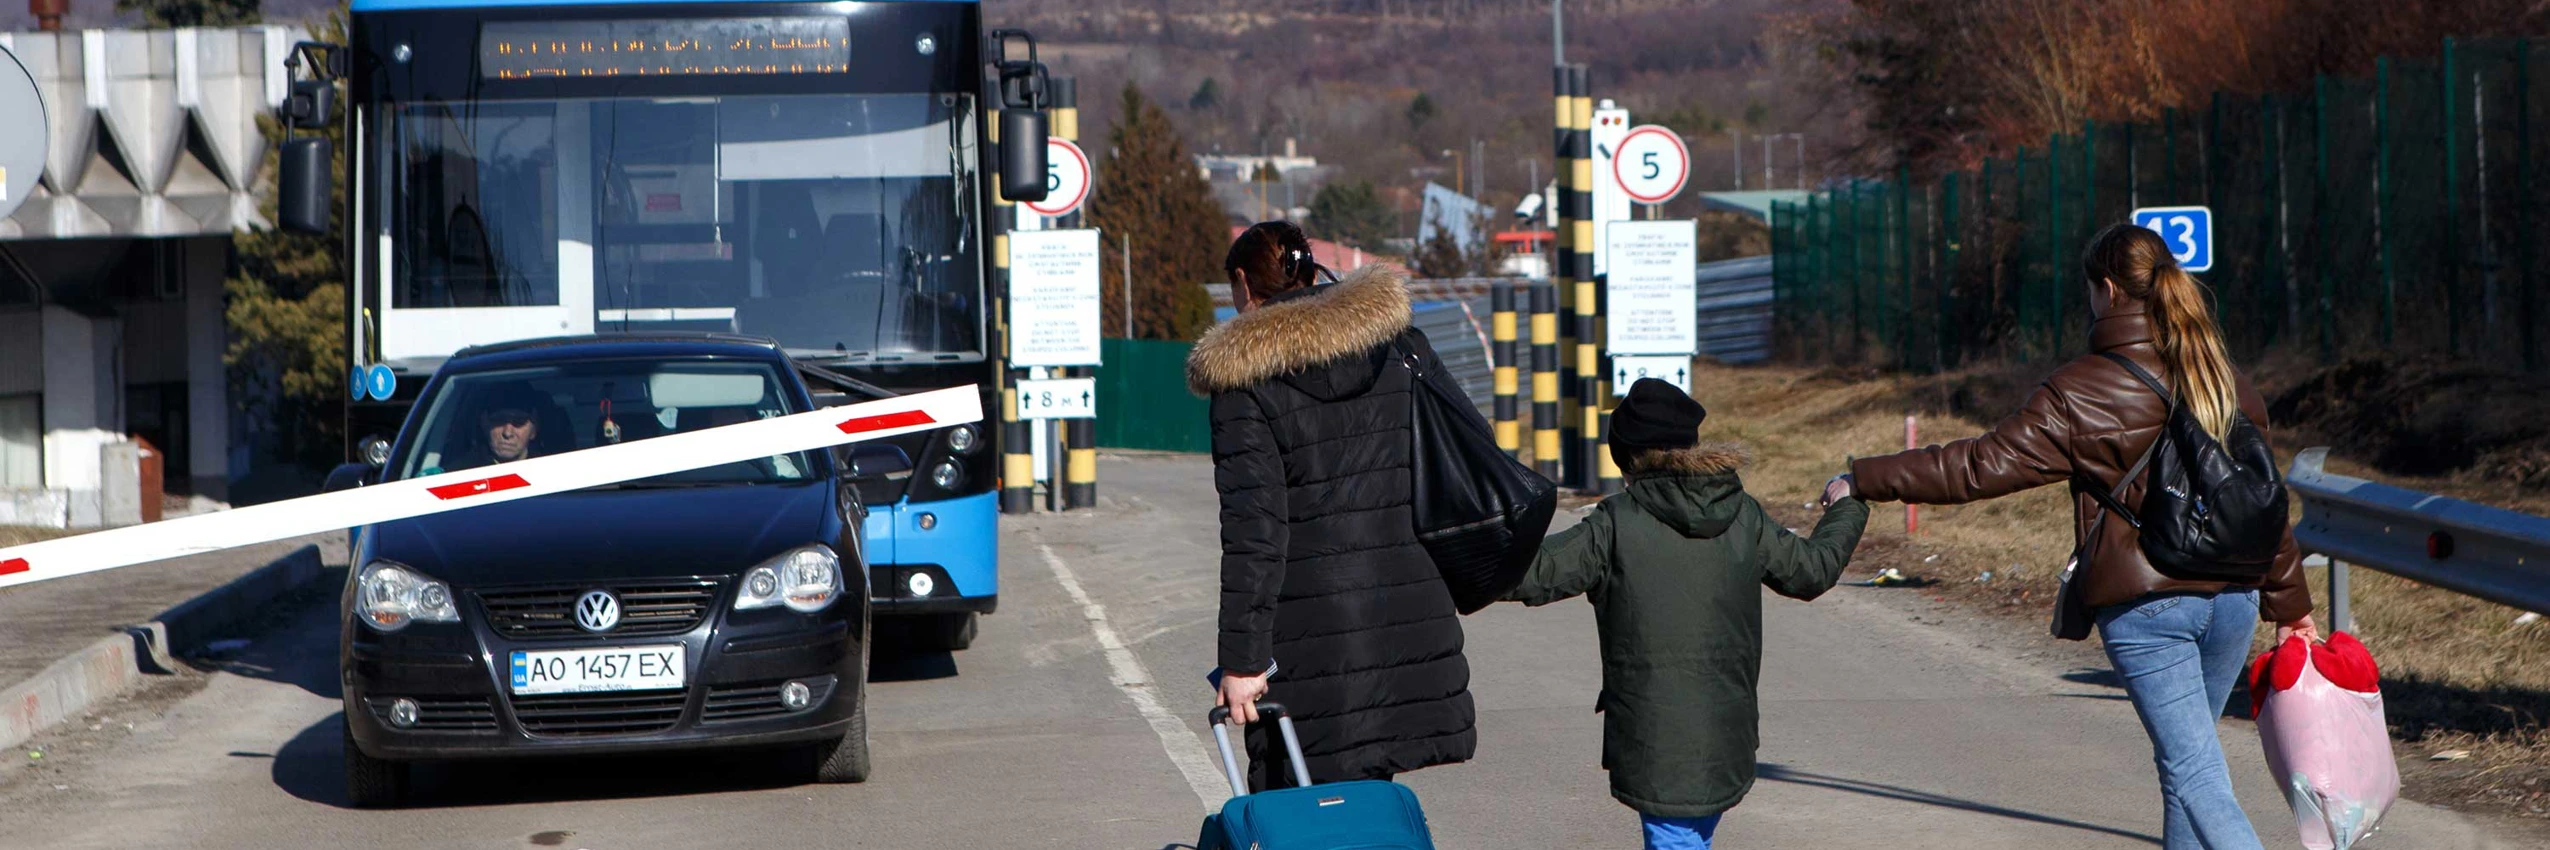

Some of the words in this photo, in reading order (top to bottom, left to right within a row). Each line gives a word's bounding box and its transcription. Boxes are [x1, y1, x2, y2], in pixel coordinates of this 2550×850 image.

[1642, 152, 1660, 180] 5
[1041, 391, 1053, 408] 8
[531, 657, 566, 682] AO
[575, 654, 632, 680] 1457
[640, 652, 675, 677] EX
[514, 674, 527, 684] UA
